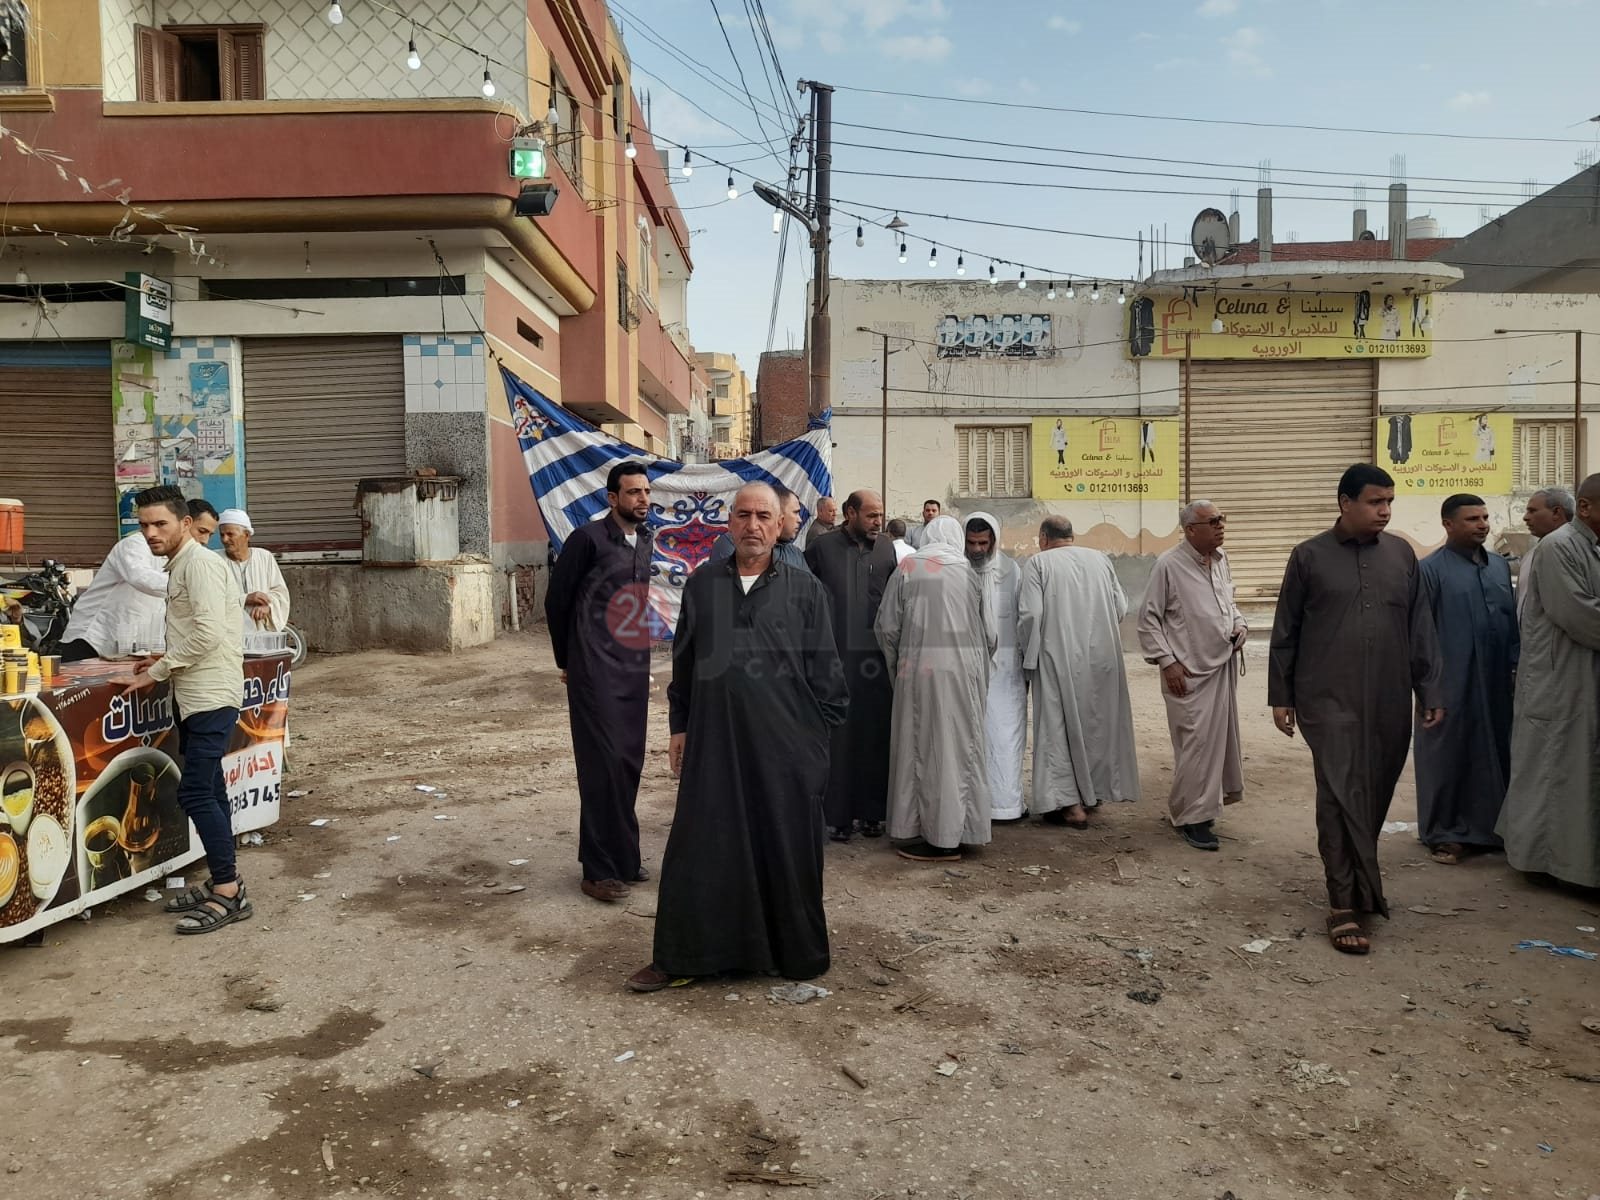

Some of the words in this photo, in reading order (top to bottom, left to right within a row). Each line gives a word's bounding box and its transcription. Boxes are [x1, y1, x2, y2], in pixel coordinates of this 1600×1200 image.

[1216, 297, 1269, 315] Celina
[1276, 297, 1290, 314] &
[1301, 299, 1344, 318] سيلينا
[1280, 325, 1287, 336] و
[1291, 321, 1338, 337] للملابس
[1369, 344, 1426, 354] 01210113693
[1086, 468, 1122, 479] الاستوكات
[1133, 468, 1163, 479] للملابس
[1089, 483, 1149, 493] 01210113693
[1429, 478, 1484, 488] 01210113693
